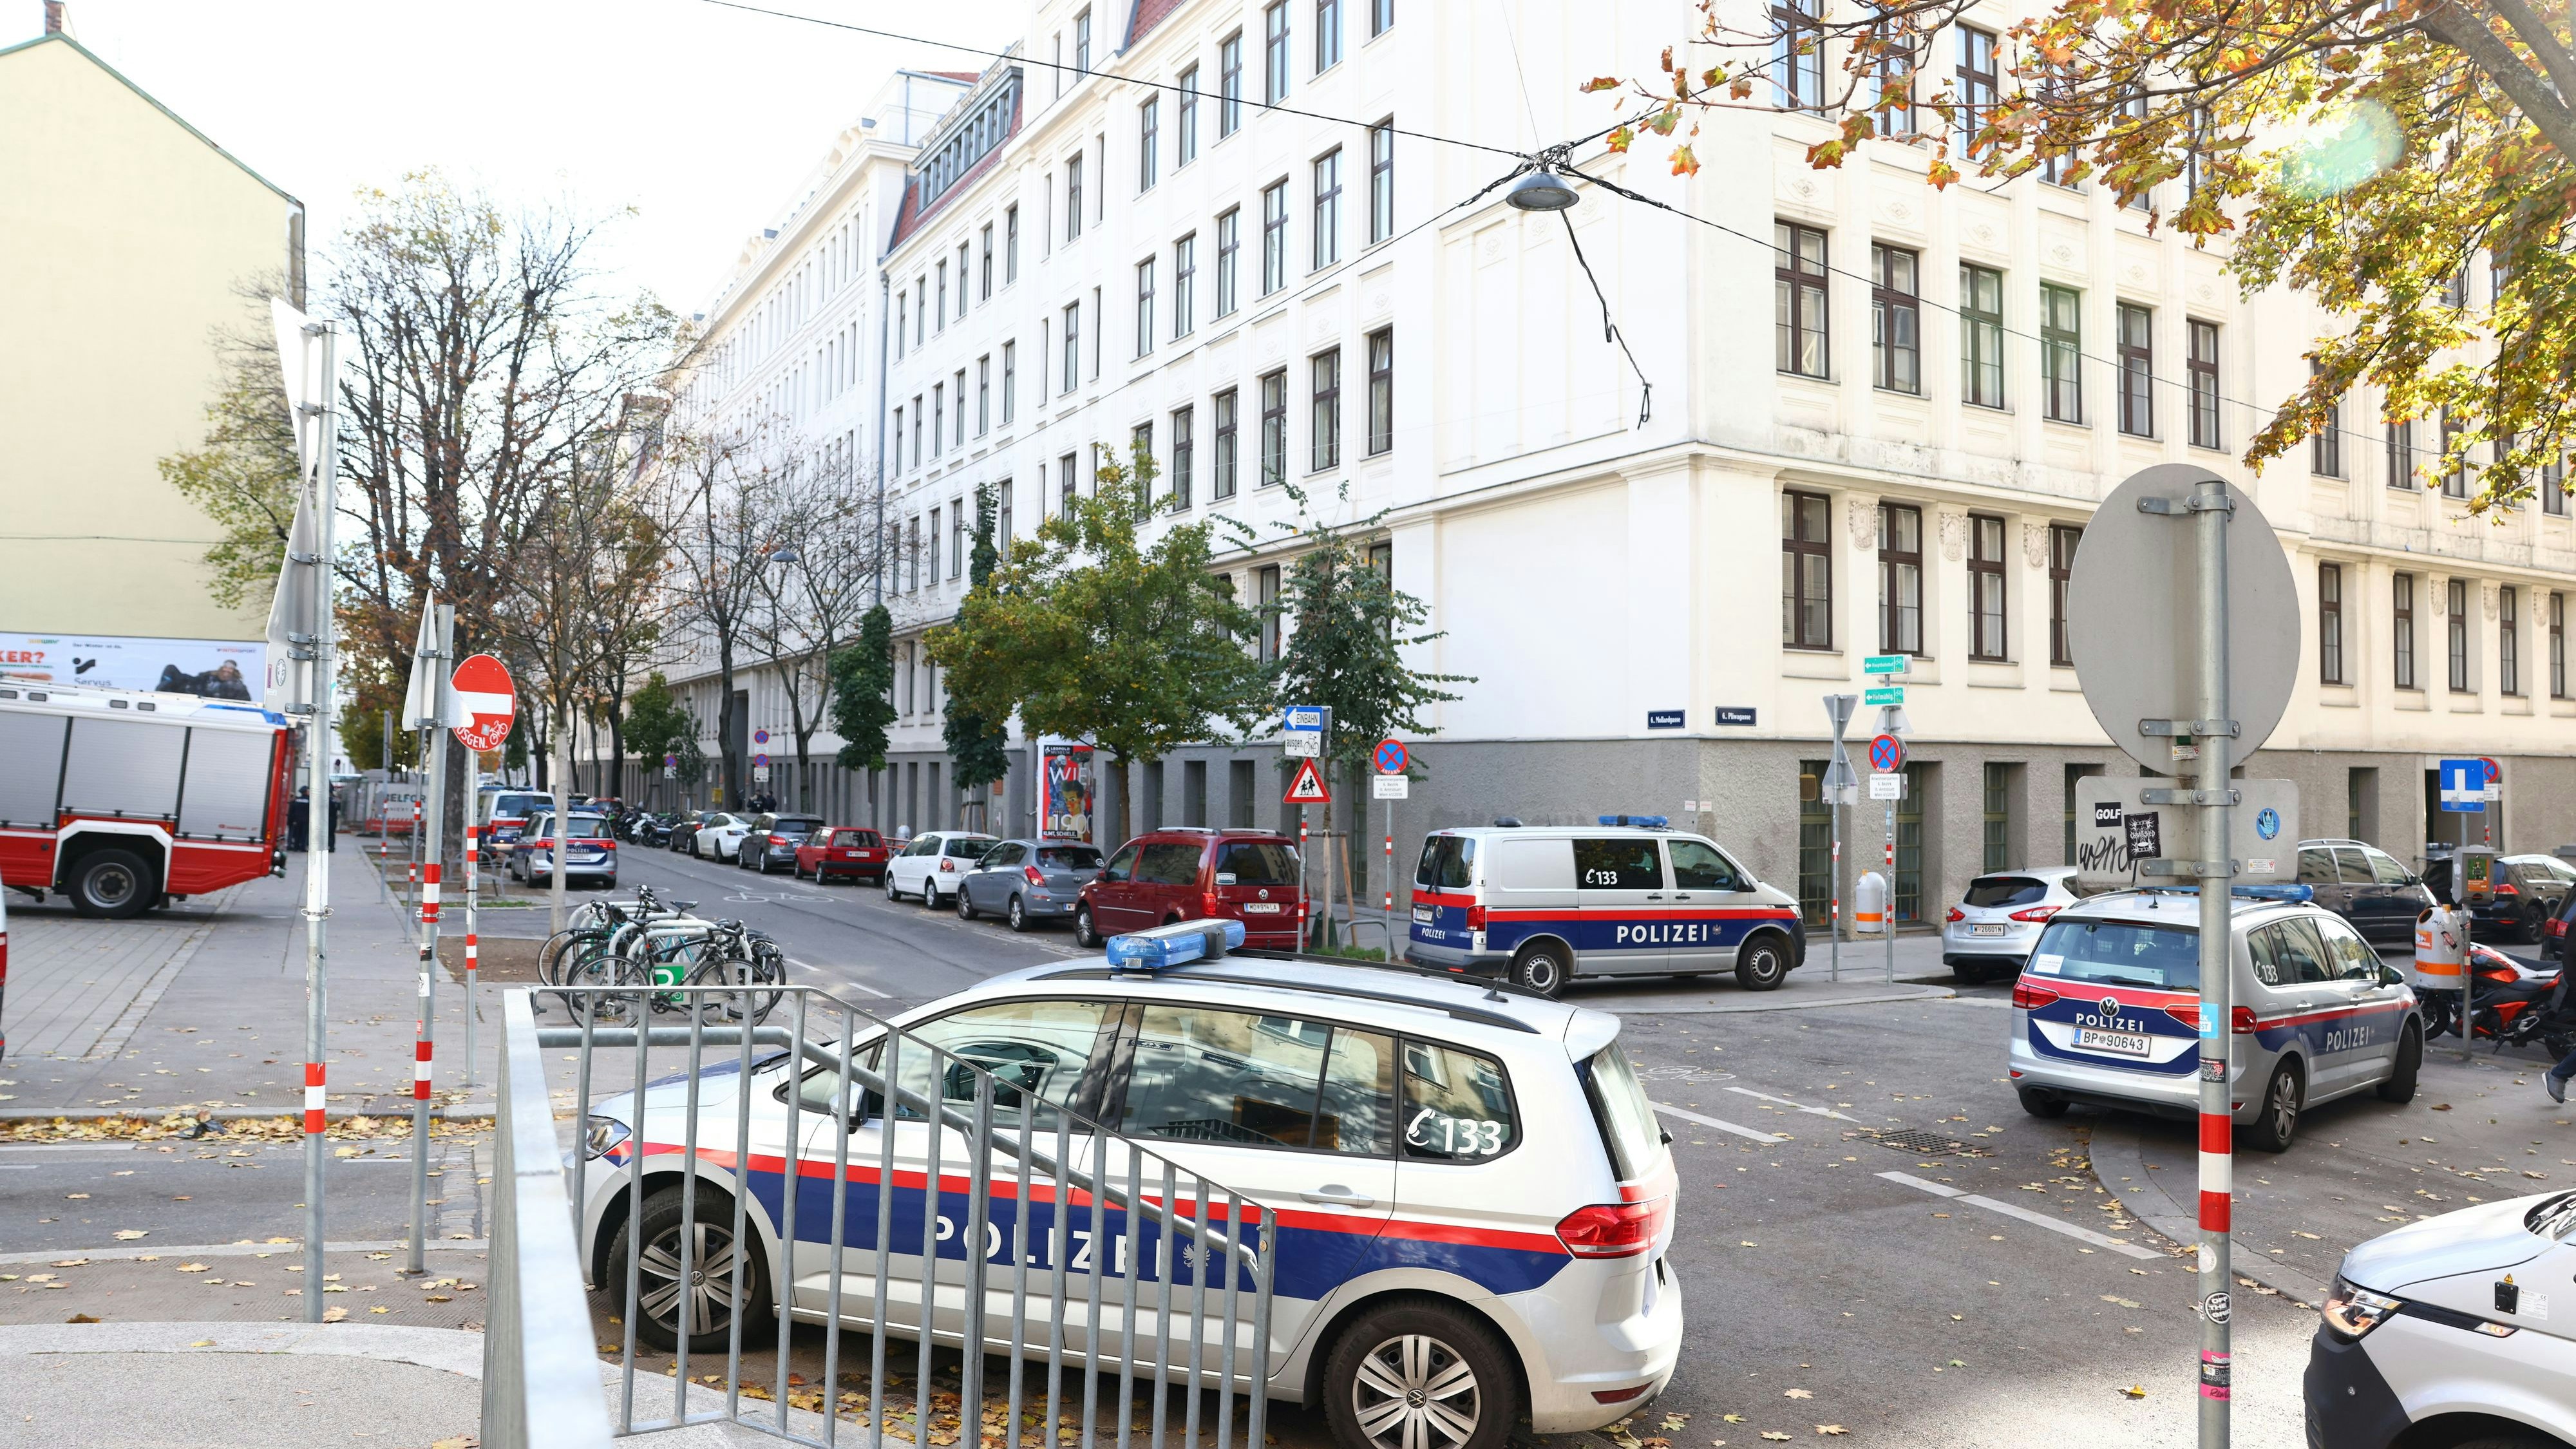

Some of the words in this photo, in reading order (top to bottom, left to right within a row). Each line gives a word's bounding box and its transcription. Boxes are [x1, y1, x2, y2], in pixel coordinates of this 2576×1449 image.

[1296, 714, 1318, 724] EINBAHN
[1656, 715, 1681, 724] Mollardgasse
[1728, 712, 1752, 721] Pliwagasse
[455, 726, 488, 749] USGEN.
[1380, 766, 1401, 775] ANFANG
[1875, 764, 1894, 774] ANFANG
[2096, 809, 2121, 820] GOLF
[1596, 871, 1618, 885] 133
[1421, 927, 1446, 940] POLIZEI
[1616, 924, 1707, 943] POLIZEI
[2262, 965, 2278, 983] 133
[2076, 1013, 2144, 1032] POLIZEI
[2084, 1032, 2098, 1044] BP
[2107, 1035, 2143, 1050] 90643
[2326, 1026, 2369, 1052] POLIZEI
[1439, 1118, 1502, 1155] 133
